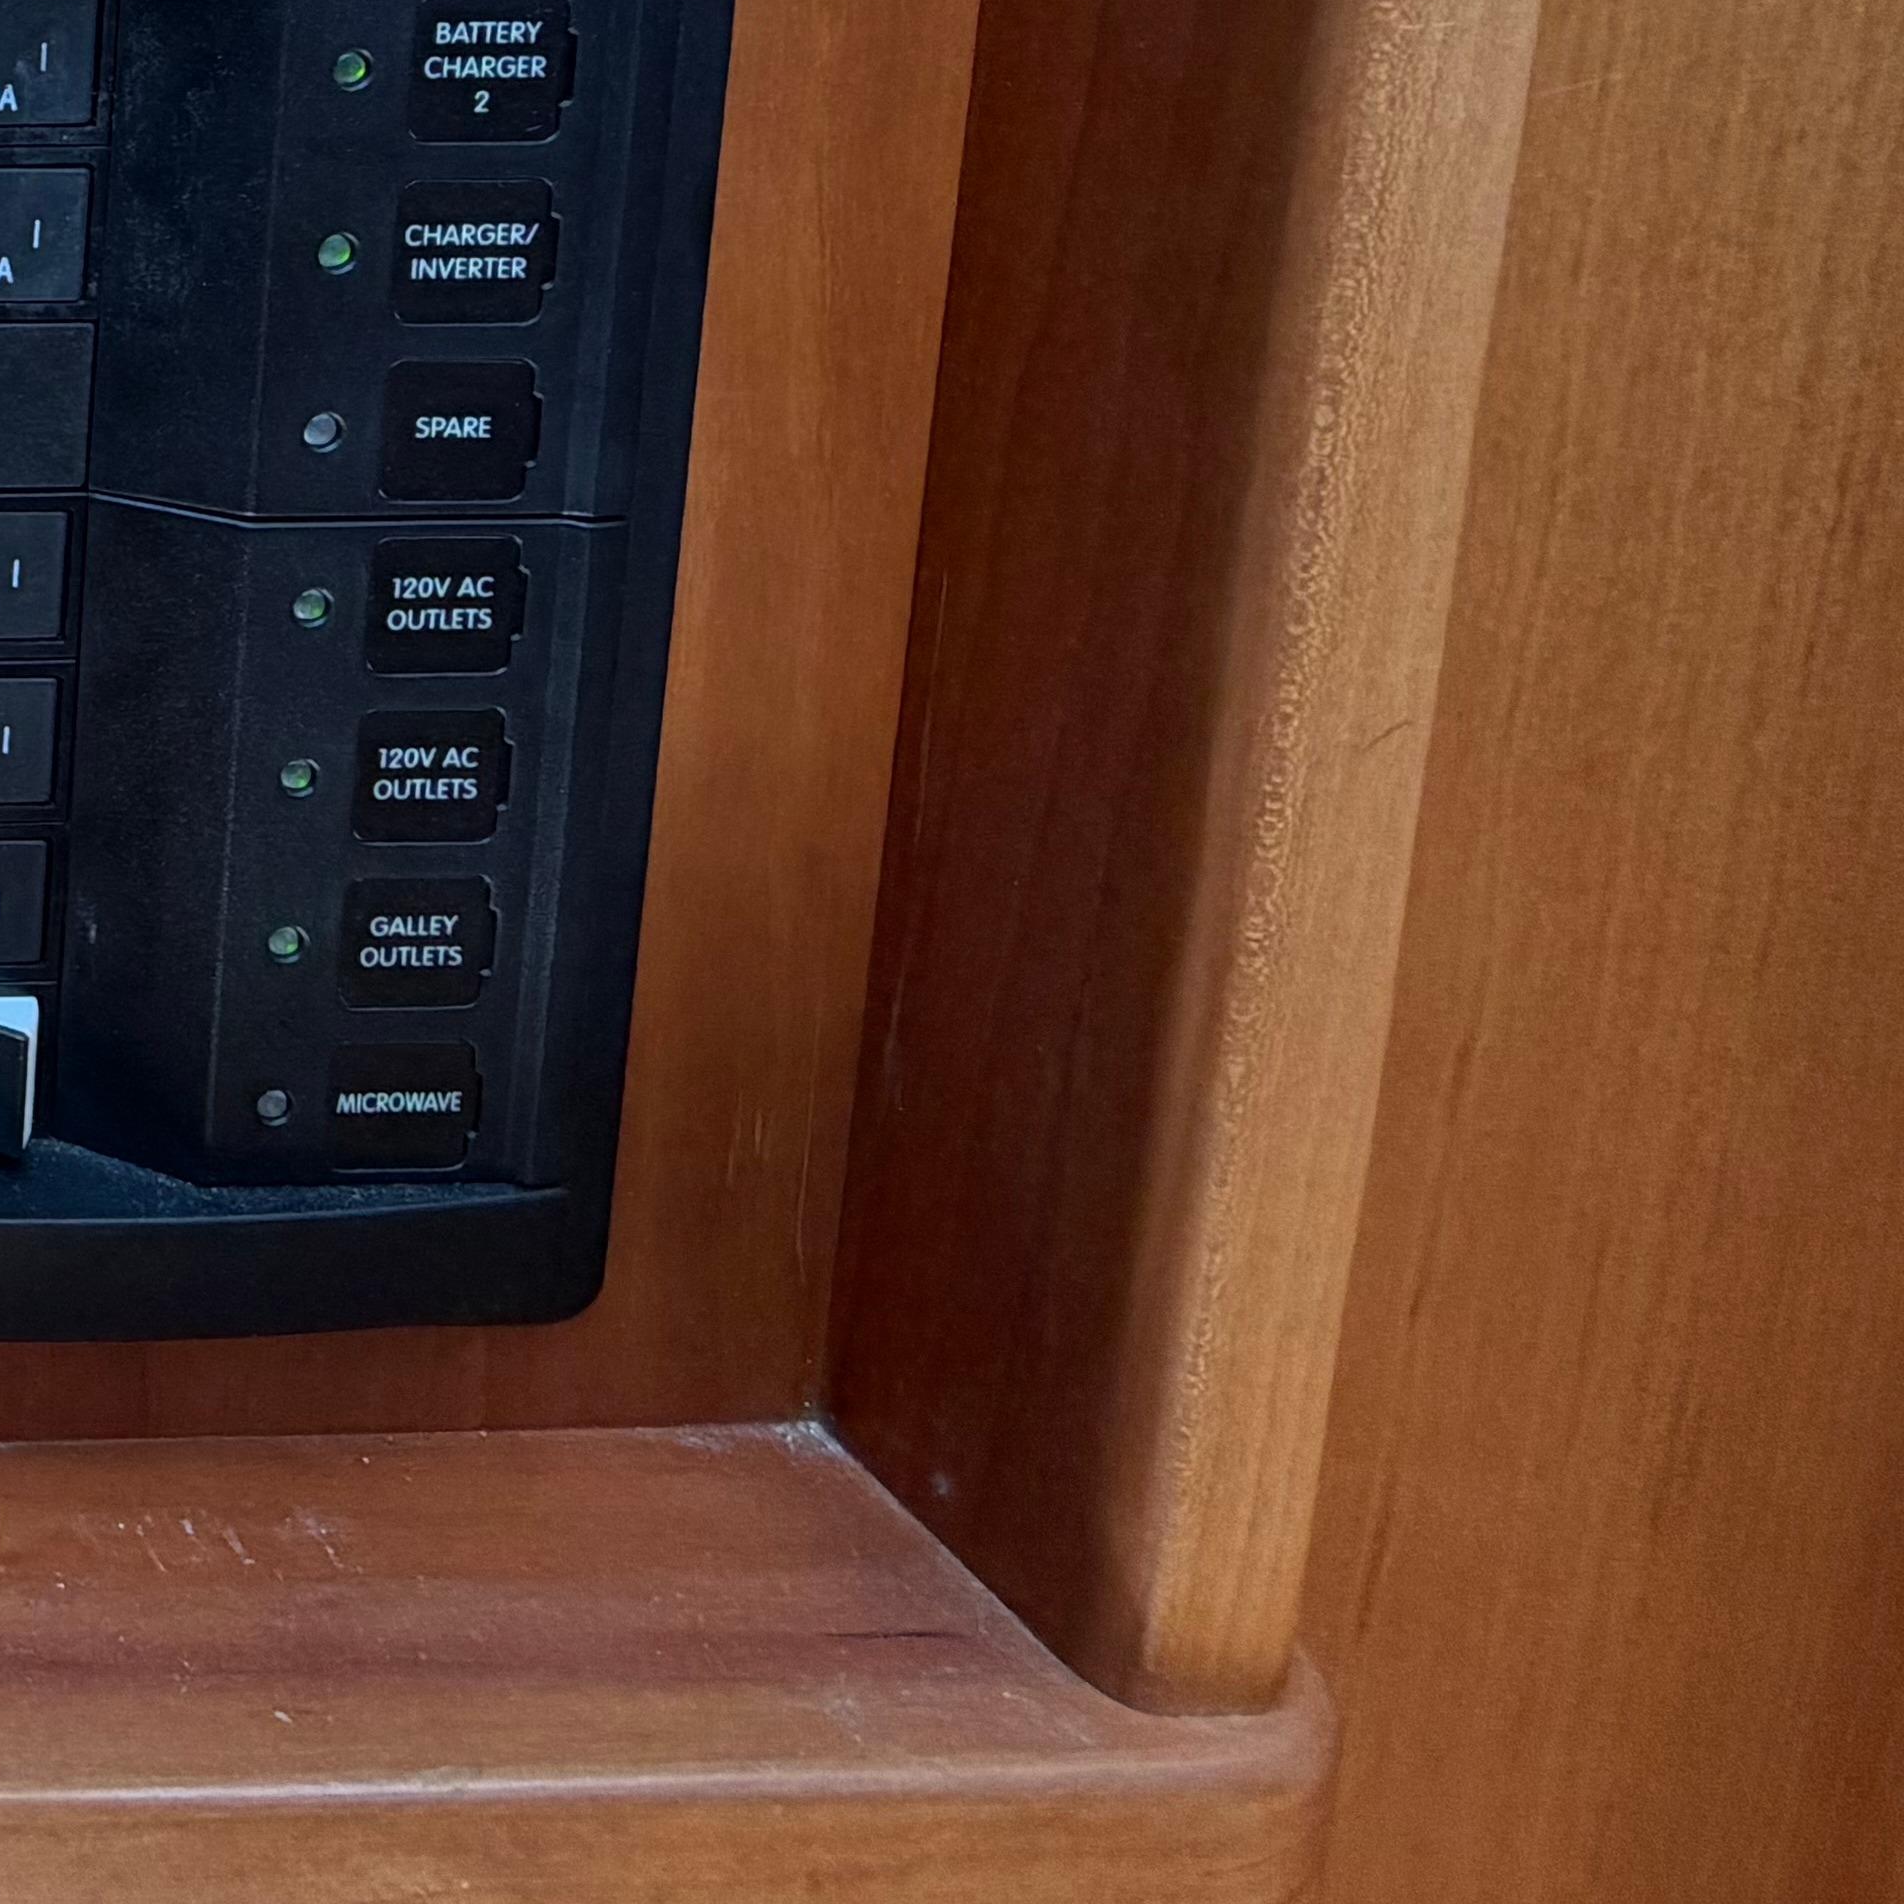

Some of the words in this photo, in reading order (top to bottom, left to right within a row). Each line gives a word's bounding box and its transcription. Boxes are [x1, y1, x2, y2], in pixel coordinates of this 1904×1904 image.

[435, 21, 544, 45] BATTERY
[423, 55, 547, 80] CHARGER
[473, 90, 490, 114] 2
[404, 222, 540, 248] CHARGER/
[410, 256, 528, 281] INVERTER
[414, 415, 492, 439] SPARE
[392, 576, 451, 599] 120V
[456, 576, 495, 598] AC
[386, 607, 493, 632] OUTLETS
[378, 747, 437, 769] 120V
[442, 746, 480, 768] AC
[373, 777, 479, 801] OUTLETS
[369, 914, 460, 938] GALLEY
[359, 945, 463, 968] OUTLETS
[335, 1091, 463, 1115] MICROWAVE
